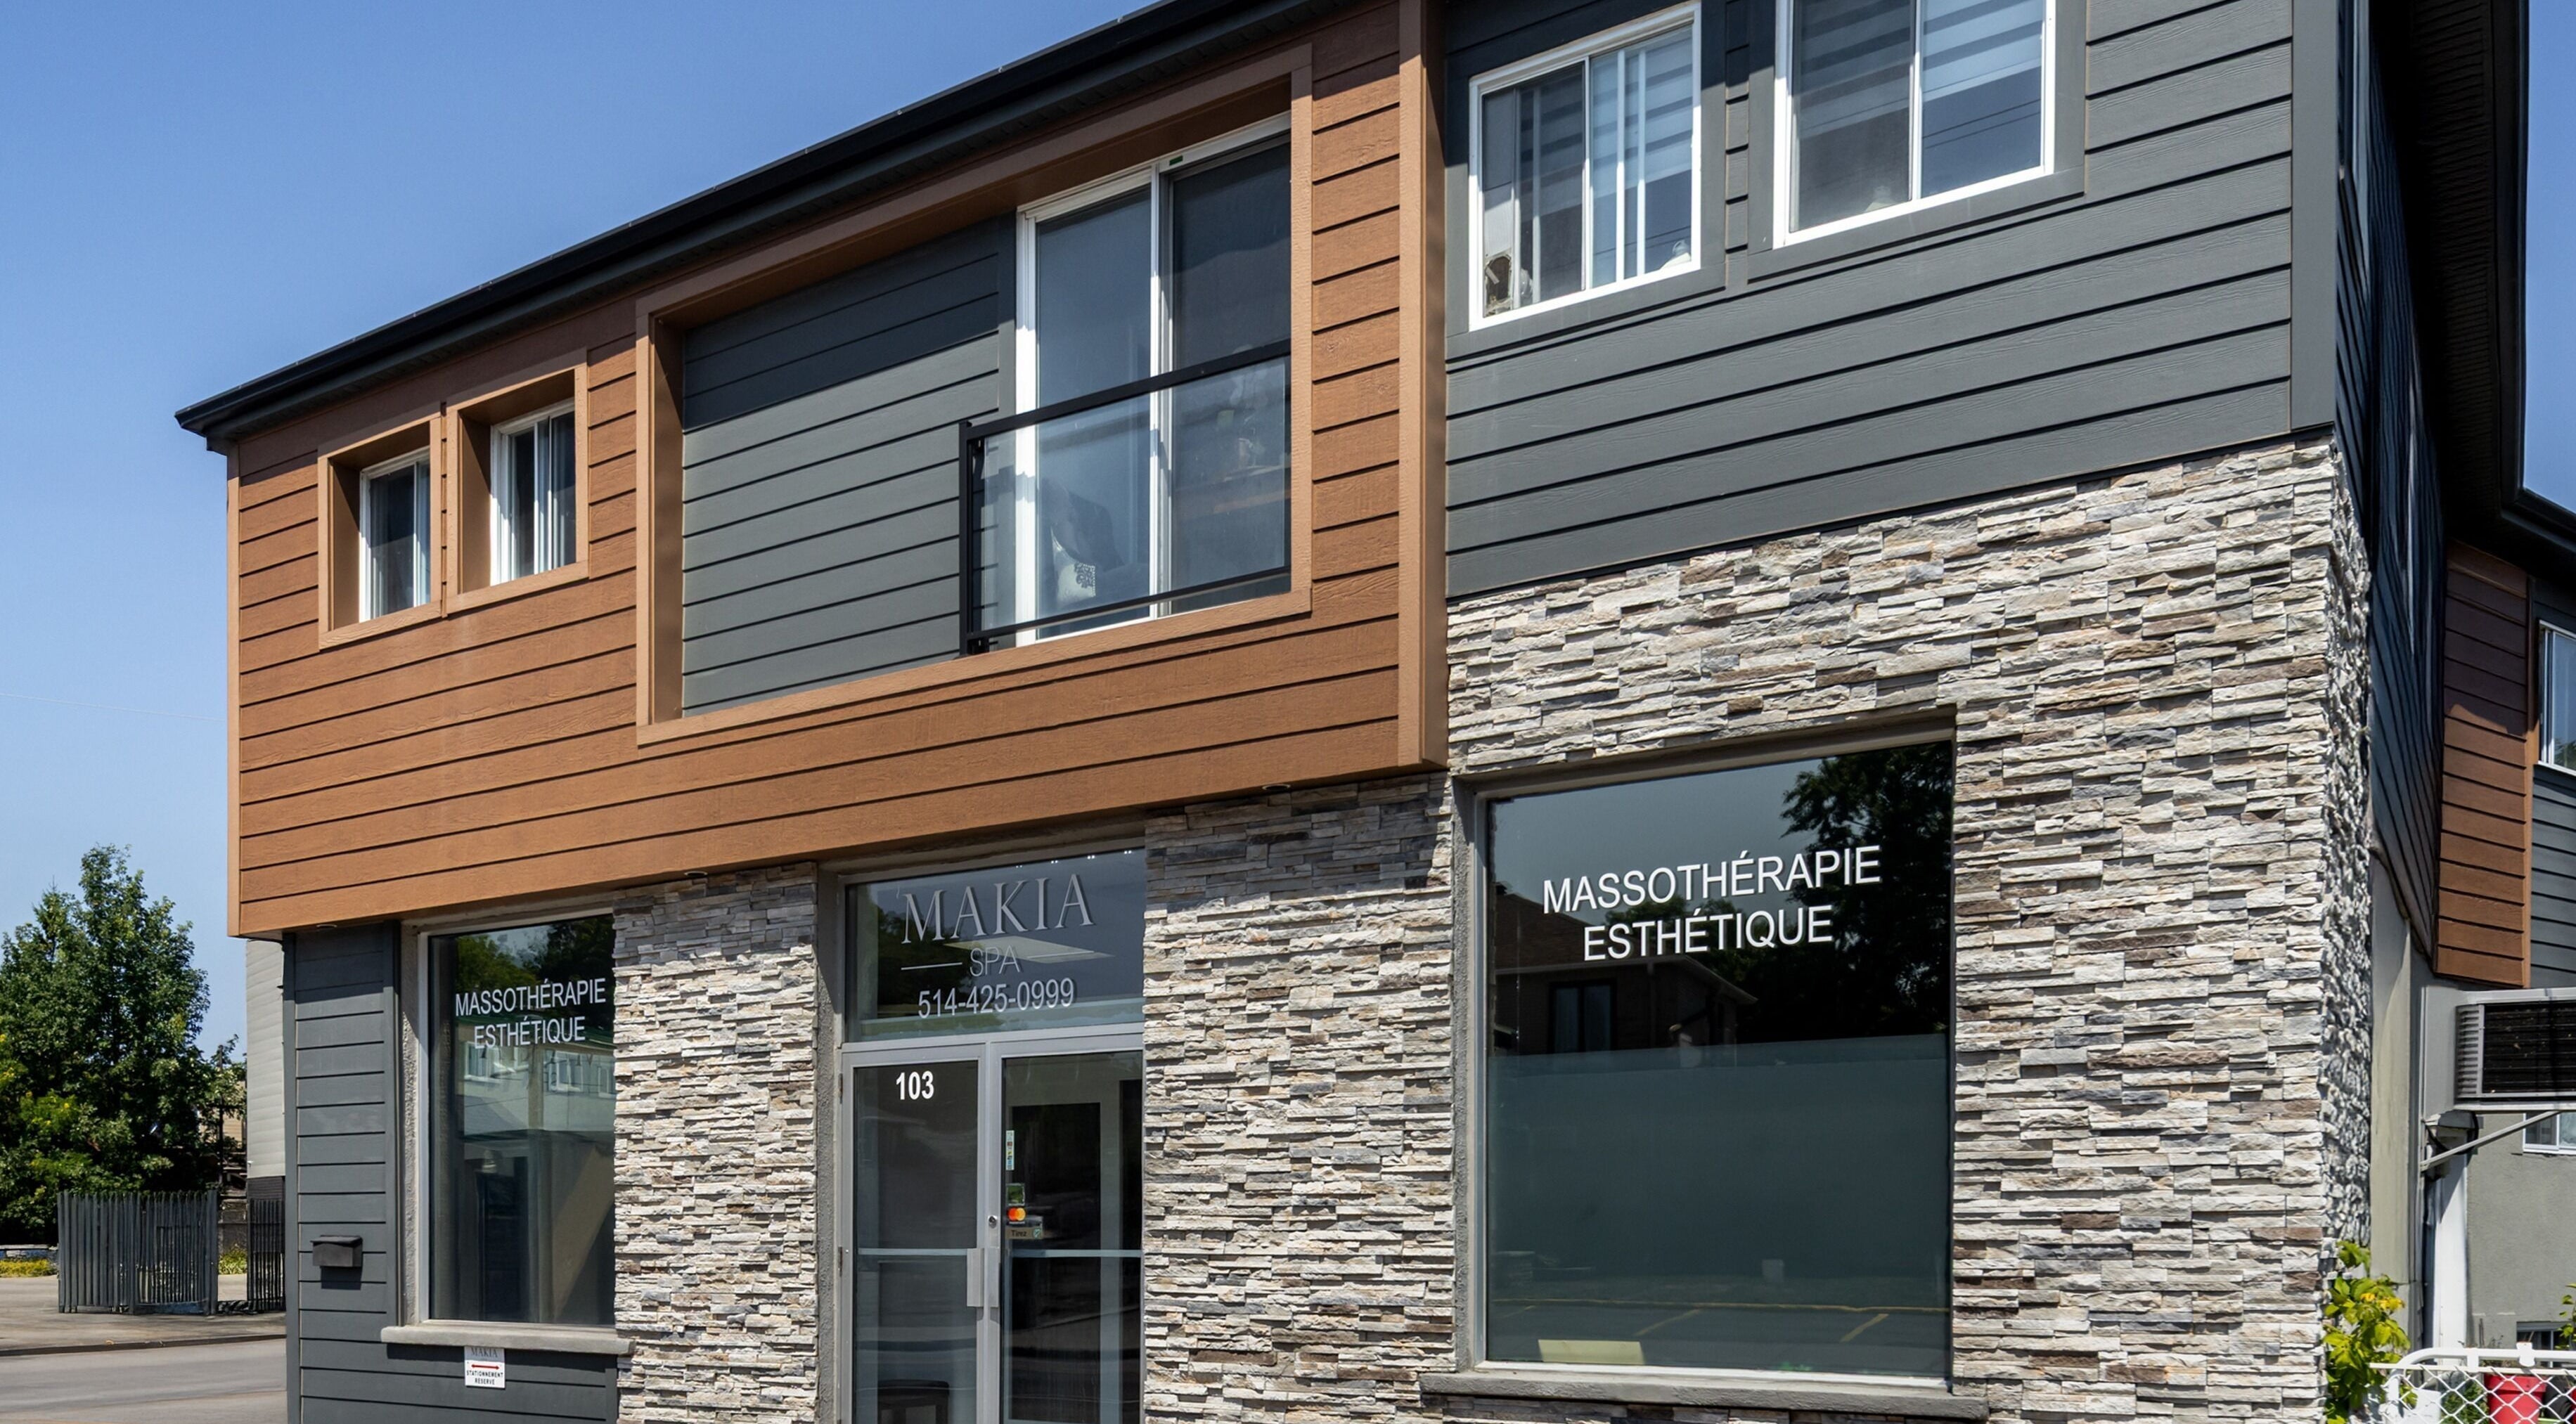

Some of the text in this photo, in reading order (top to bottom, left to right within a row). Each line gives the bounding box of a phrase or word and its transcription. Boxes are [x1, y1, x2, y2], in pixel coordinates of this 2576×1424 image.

[1543, 845, 1881, 914] MASSOTHÉRAPIE
[901, 874, 1095, 944] MAKIA
[1583, 905, 1833, 961] ESTHÉTIQUE
[970, 945, 1020, 977] SPA
[456, 978, 606, 1016] MASSOTHÉRAPIE
[917, 978, 1075, 1018] 514-425-0999
[473, 1016, 586, 1049] ESTHÉTIQUE
[896, 1070, 934, 1100] 103
